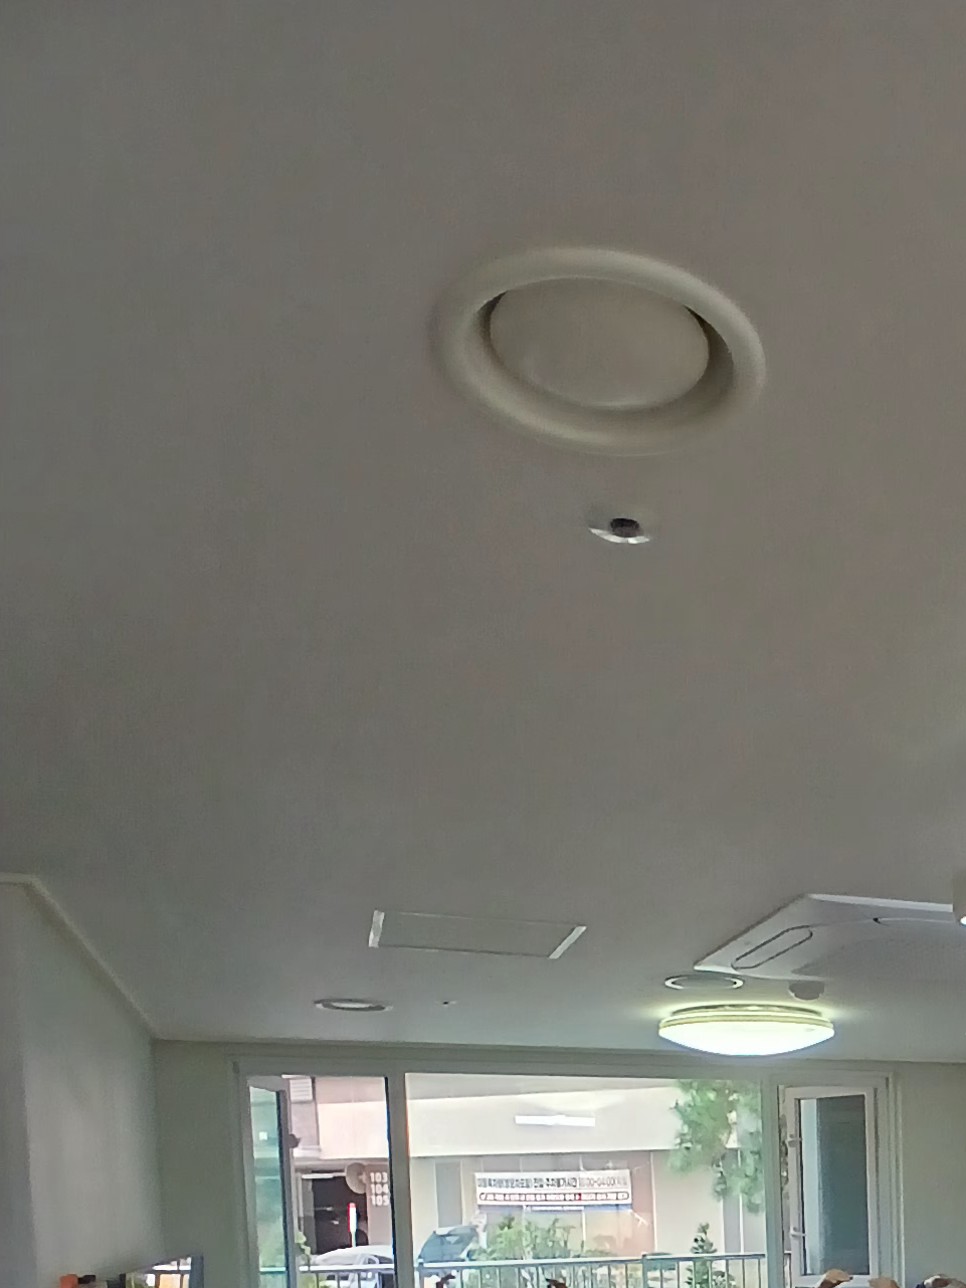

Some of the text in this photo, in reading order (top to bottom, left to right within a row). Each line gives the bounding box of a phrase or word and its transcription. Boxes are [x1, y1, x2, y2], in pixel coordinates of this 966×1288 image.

[370, 1171, 388, 1183] 103
[370, 1183, 389, 1194] 104
[370, 1195, 390, 1206] 105
